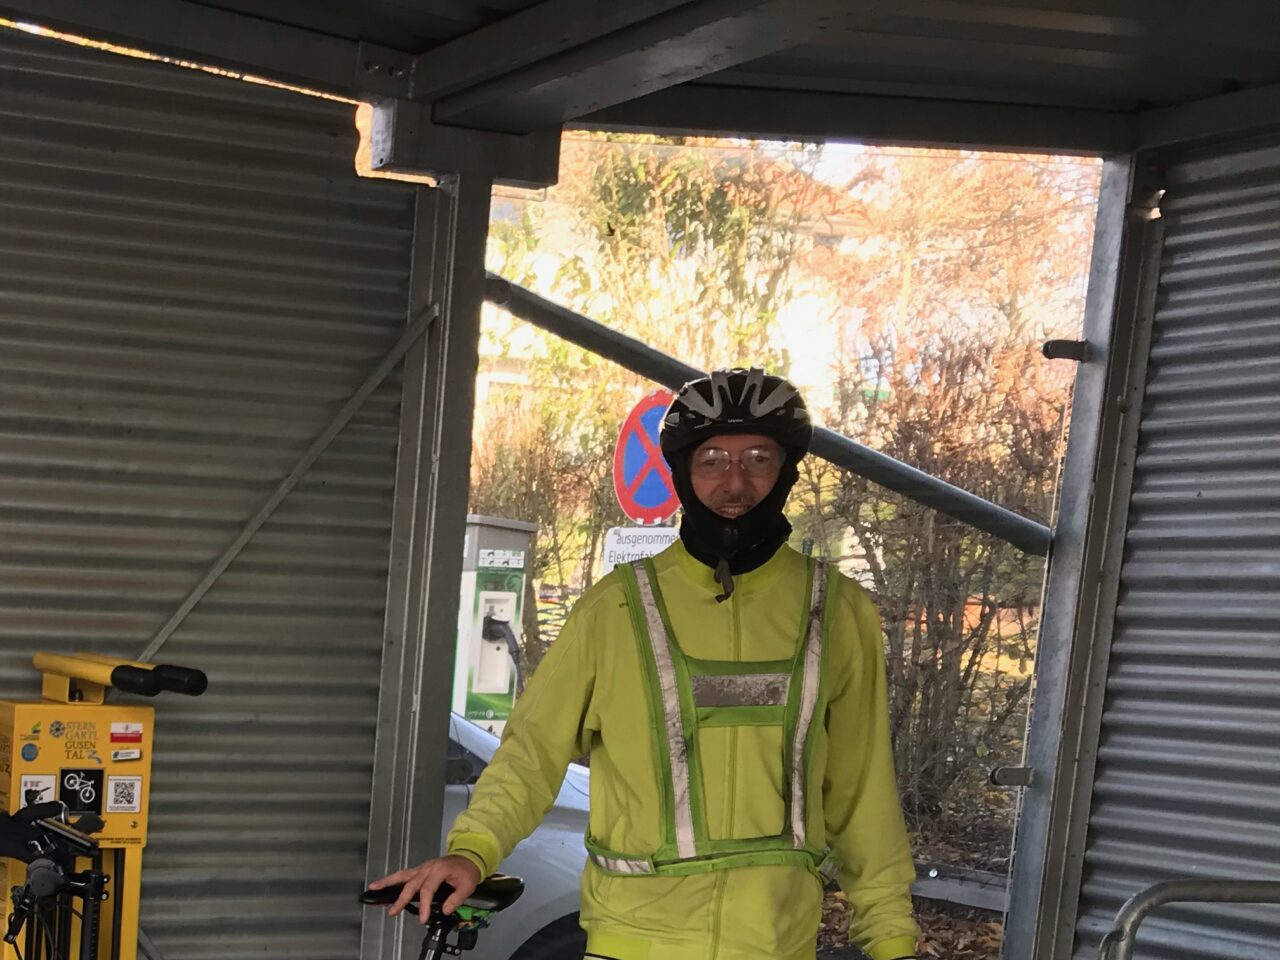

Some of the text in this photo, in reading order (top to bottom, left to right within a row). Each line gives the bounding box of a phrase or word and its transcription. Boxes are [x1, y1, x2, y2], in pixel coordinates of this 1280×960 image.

[616, 534, 679, 547] ausgenomme
[64, 740, 97, 749] GUSEN
[64, 750, 85, 759] TAL
